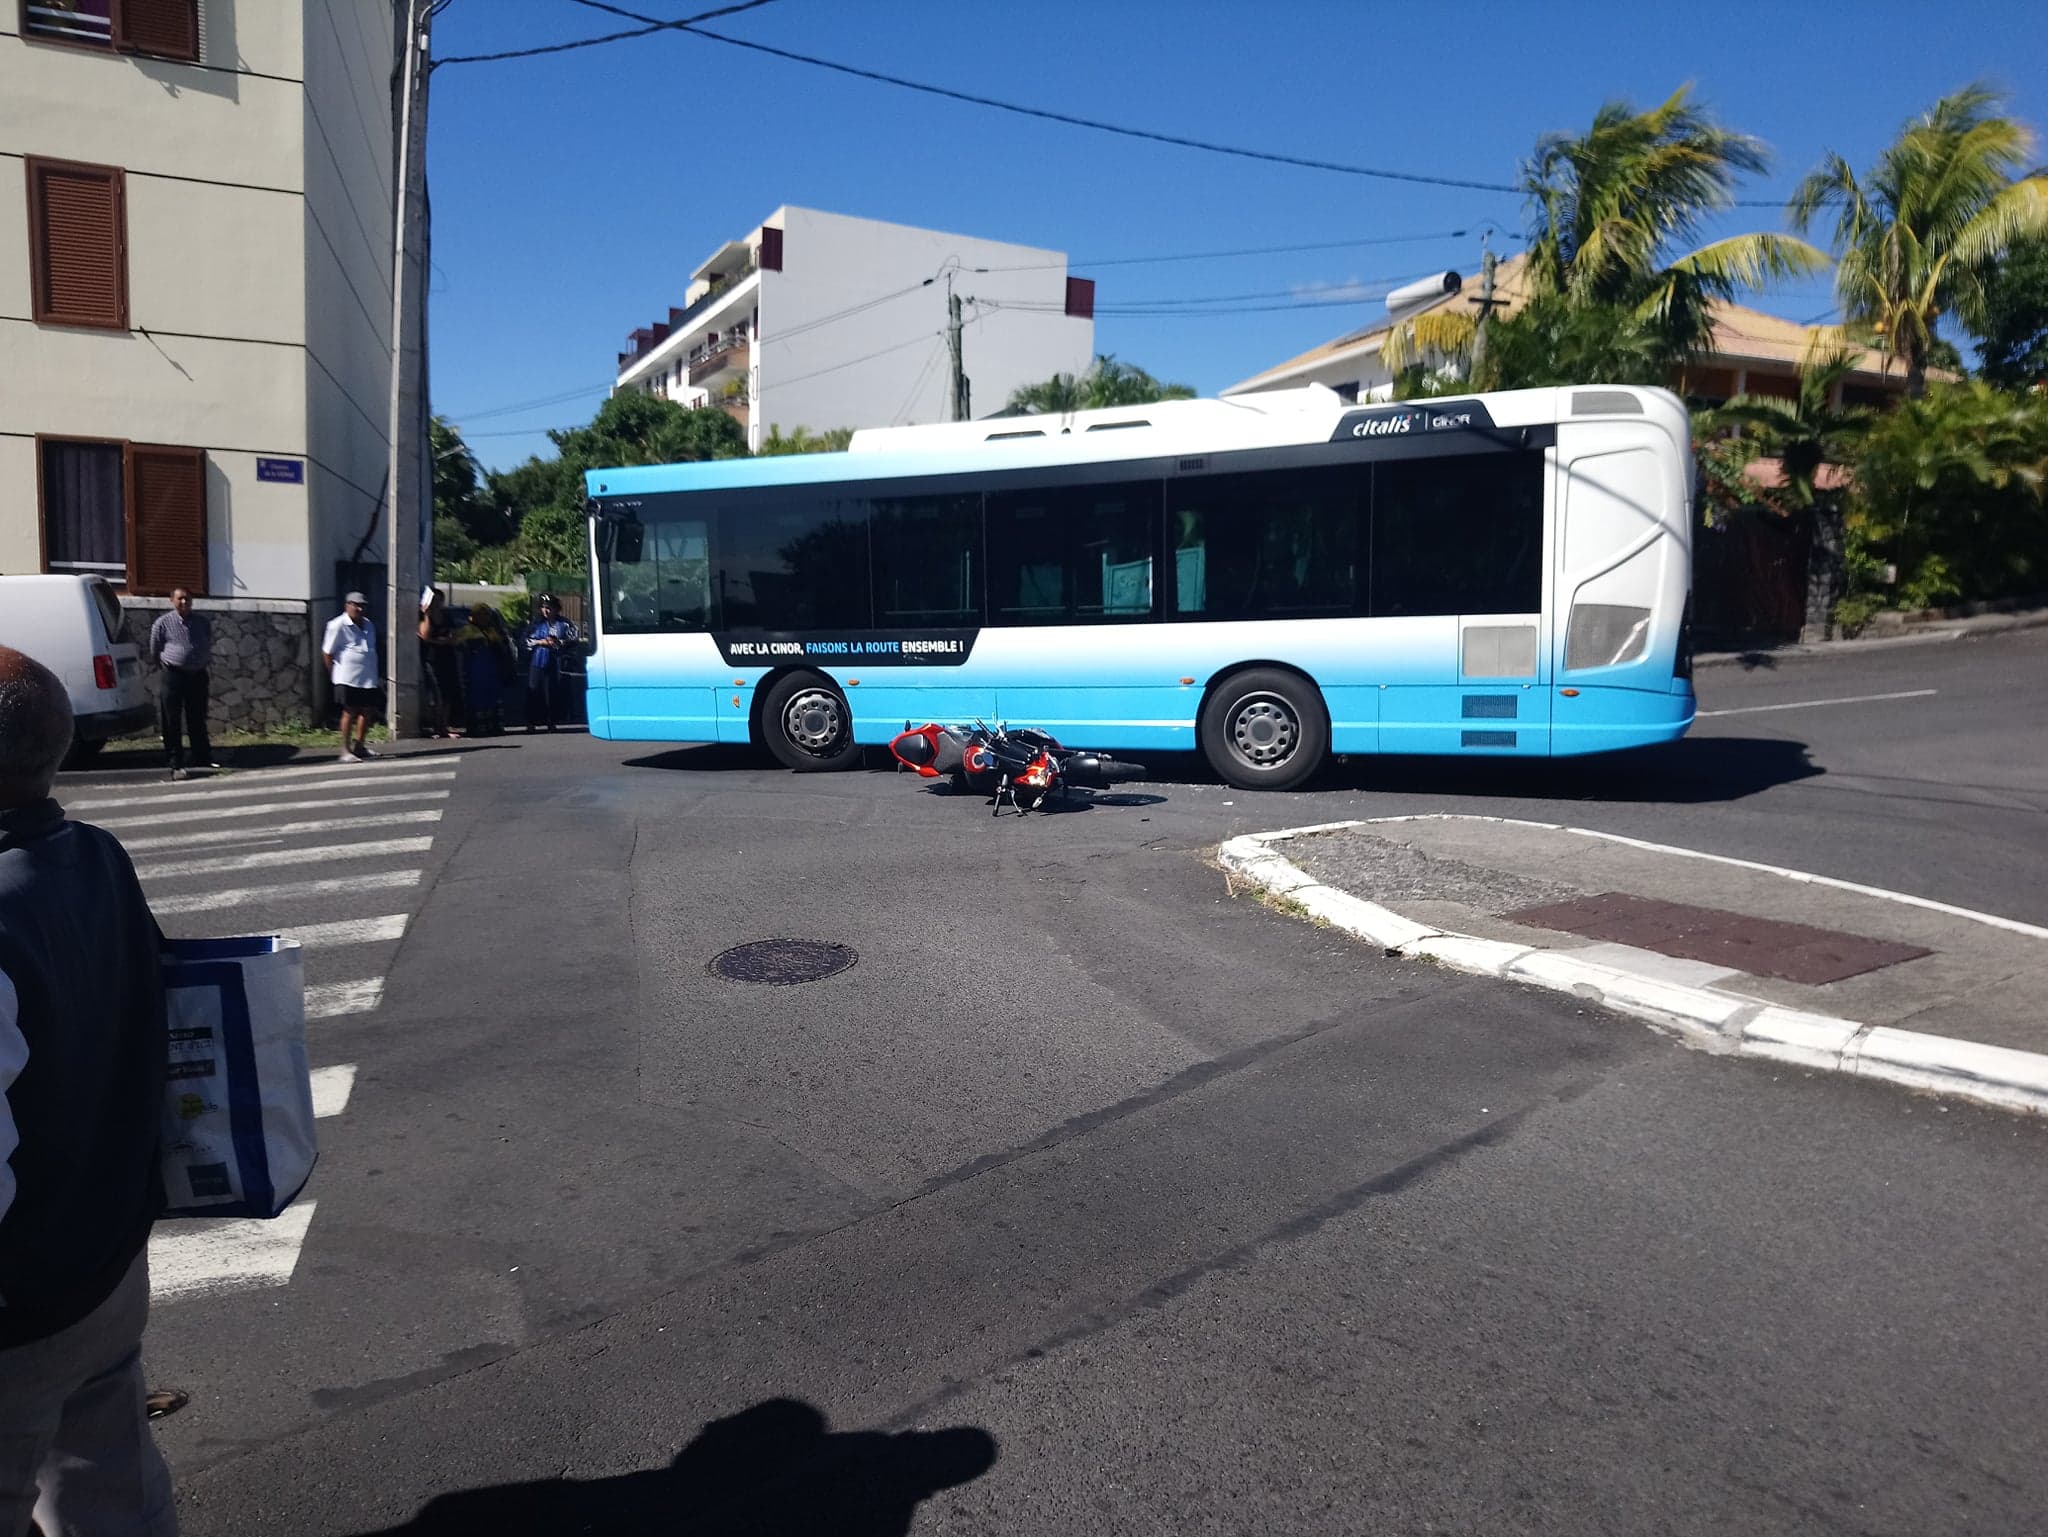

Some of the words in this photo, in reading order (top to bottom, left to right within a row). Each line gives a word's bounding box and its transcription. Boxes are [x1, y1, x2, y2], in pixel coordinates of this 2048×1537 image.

[1353, 414, 1411, 437] citalis
[730, 642, 755, 655] AVEC
[756, 642, 770, 654] LA
[771, 642, 804, 655] CINOR,
[806, 642, 848, 653] FAISONS
[850, 642, 864, 653] LA
[865, 641, 899, 653] ROUTE
[902, 640, 957, 653] ENSEMBLE
